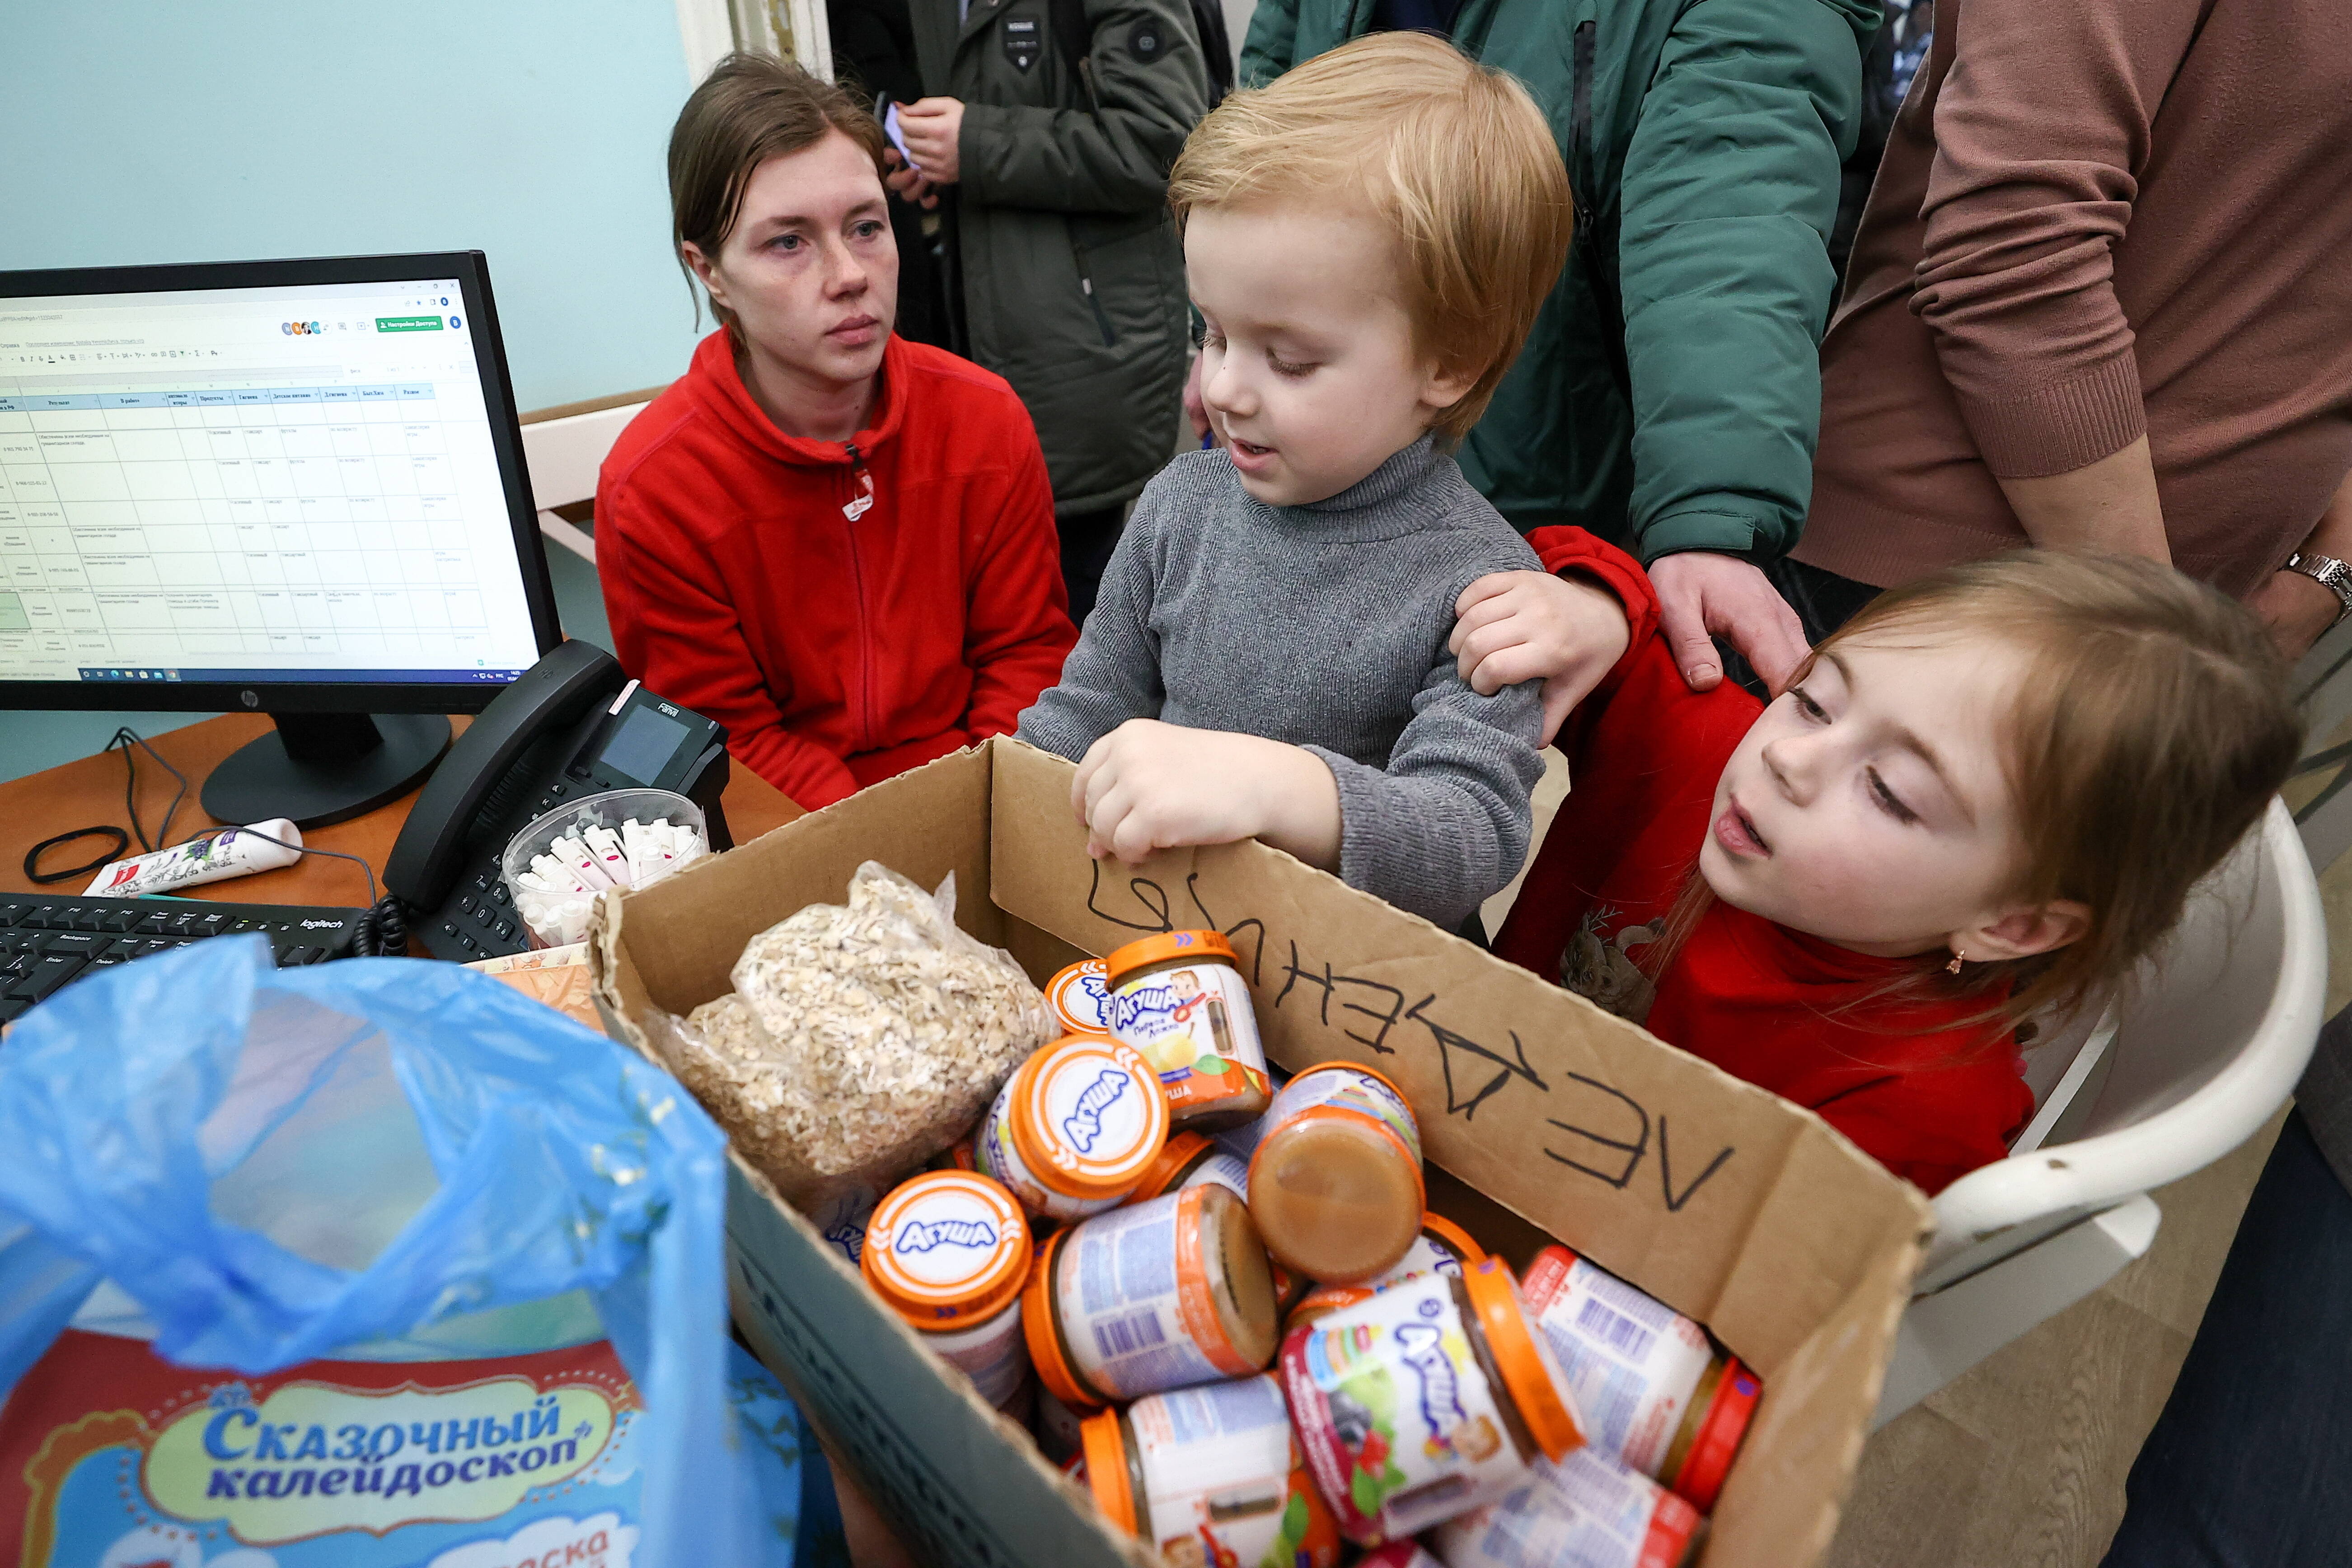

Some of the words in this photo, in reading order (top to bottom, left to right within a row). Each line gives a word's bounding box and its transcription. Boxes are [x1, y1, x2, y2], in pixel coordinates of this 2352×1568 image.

[657, 702, 679, 717] Fanvil
[475, 875, 484, 884] 7
[493, 888, 501, 896] 8
[478, 909, 485, 918] 0
[300, 918, 343, 930] logitech
